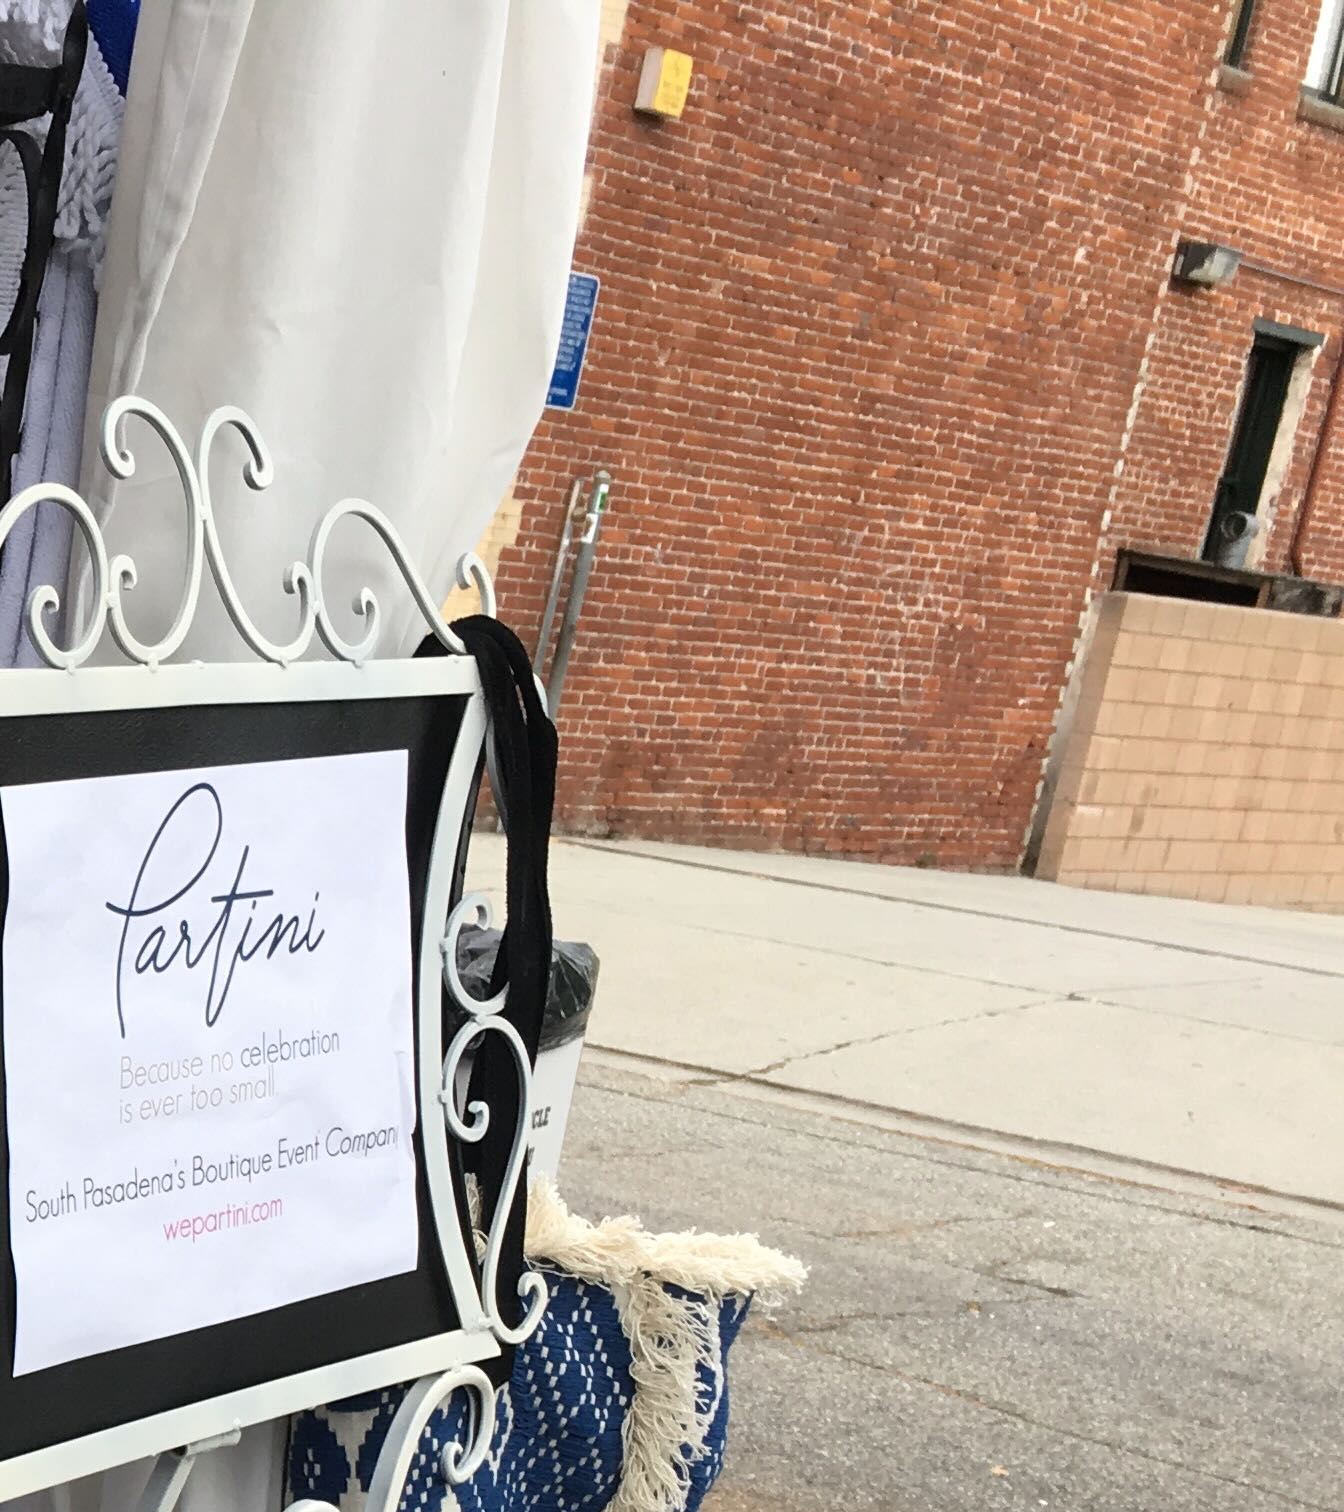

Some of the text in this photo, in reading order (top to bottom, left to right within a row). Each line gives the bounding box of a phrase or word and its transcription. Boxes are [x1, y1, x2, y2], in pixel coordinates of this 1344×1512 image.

[105, 782, 326, 1040] Partini
[119, 1028, 341, 1090] Because no celebration
[119, 1099, 133, 1125] is
[138, 1093, 184, 1121] ever
[190, 1084, 224, 1112] too
[25, 1126, 400, 1223] South Pasadena's Boutique Event Compan
[163, 1198, 283, 1243] wepartini.com
